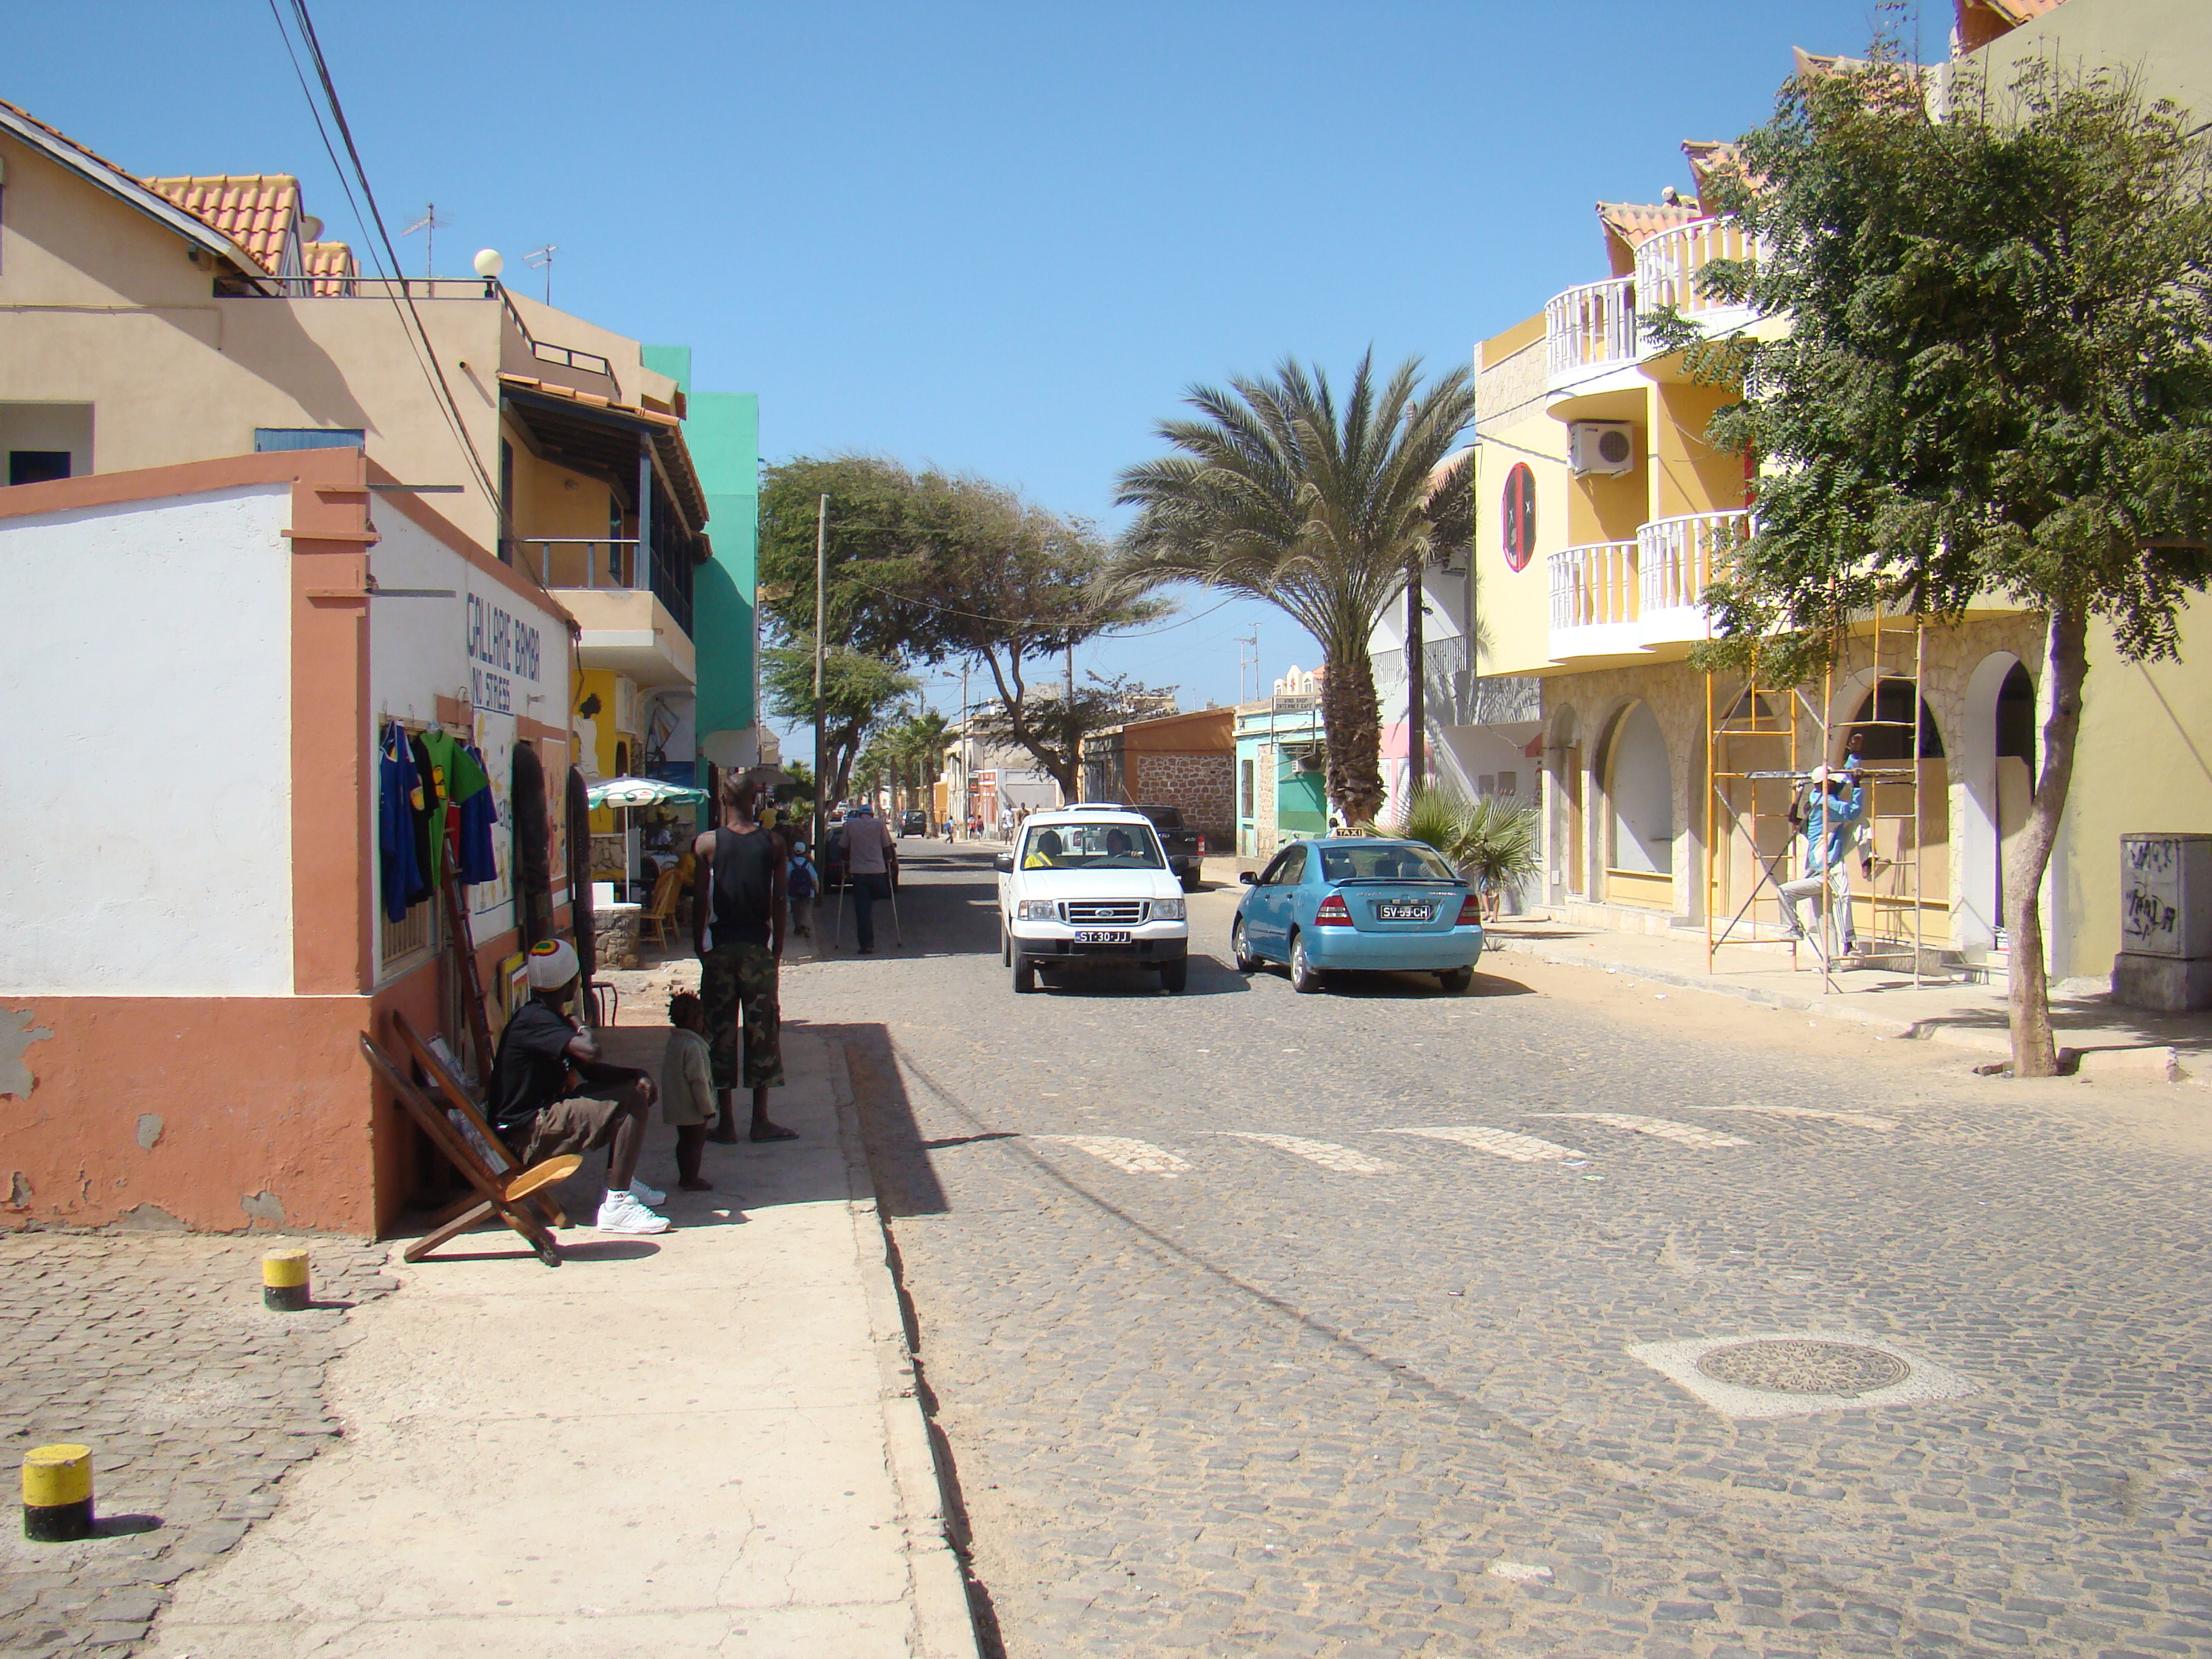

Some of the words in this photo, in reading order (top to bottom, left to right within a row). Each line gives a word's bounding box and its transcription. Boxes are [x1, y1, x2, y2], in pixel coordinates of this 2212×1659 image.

[515, 619, 540, 683] BAMBA
[472, 667, 483, 705] NO
[487, 672, 510, 712] STRESS
